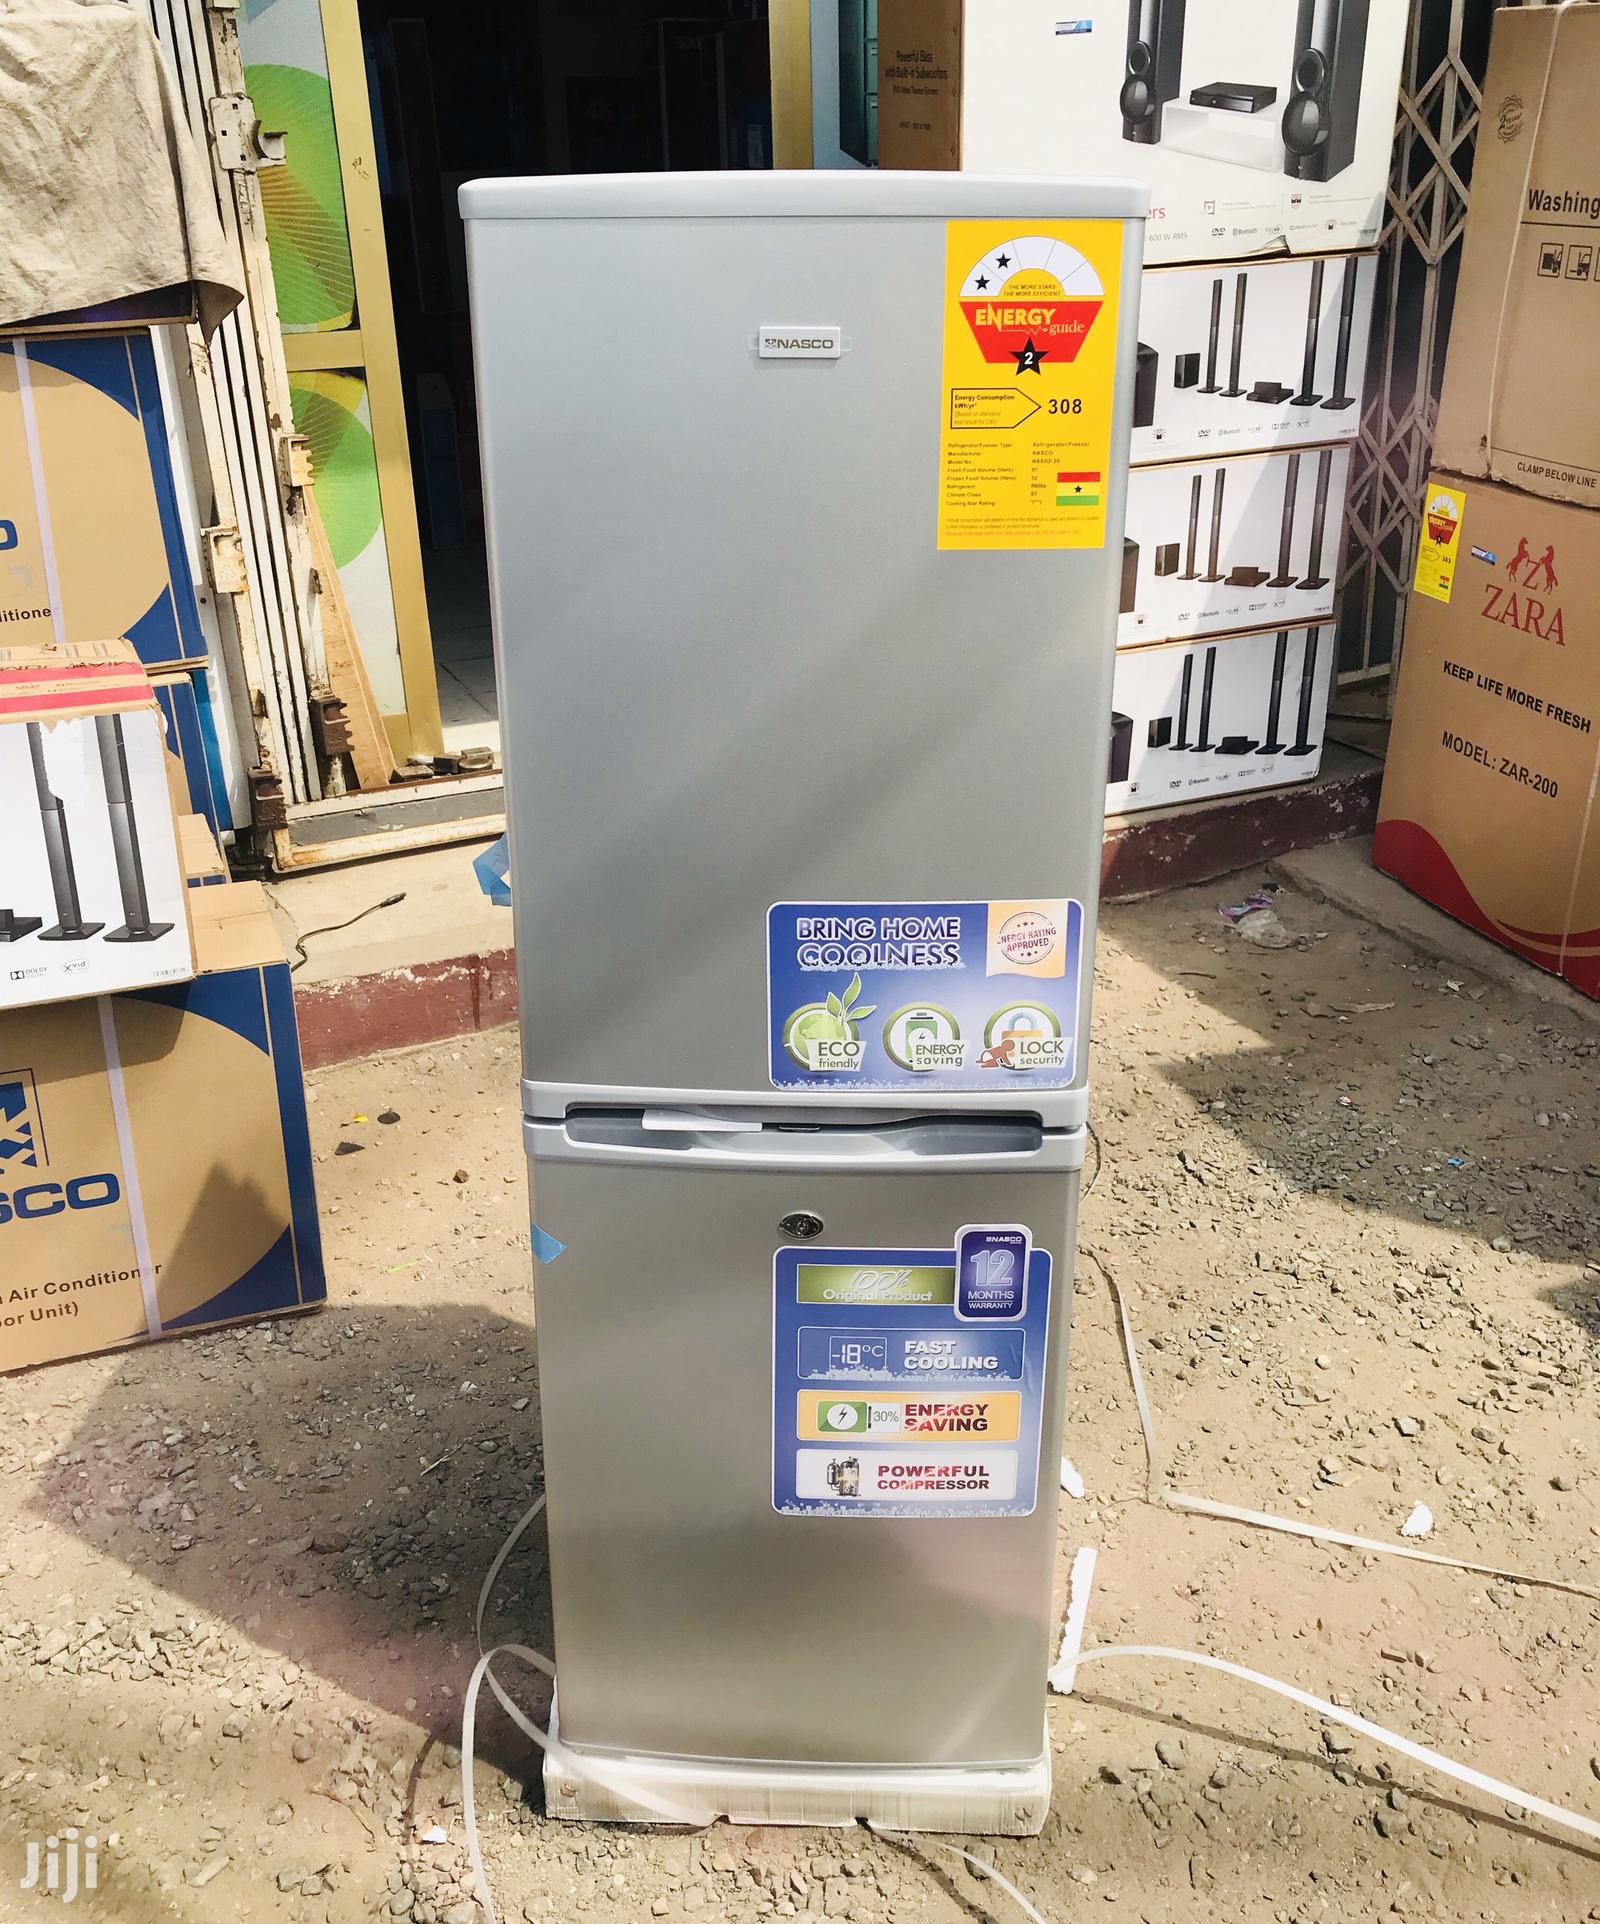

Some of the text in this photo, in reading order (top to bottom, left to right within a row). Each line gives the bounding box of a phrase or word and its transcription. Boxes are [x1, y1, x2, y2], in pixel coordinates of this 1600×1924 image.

[1528, 188, 1600, 219] Washing
[1149, 234, 1162, 242] 600
[1172, 232, 1188, 240] RMS
[975, 303, 1057, 332] ENERGY
[1049, 319, 1085, 336] guide
[777, 339, 834, 349] NASCO
[1024, 352, 1034, 365] 2
[1048, 398, 1083, 415] 308
[1517, 461, 1597, 489] CLAMP BELOW LINE
[1481, 583, 1566, 646] ZARA
[1443, 660, 1592, 734] KEEP LIFE MORE FRESH
[1442, 730, 1559, 798] MODEL: ZAR-200
[797, 916, 961, 940] BRING HOME
[1028, 926, 1057, 939] RATING
[1007, 937, 1050, 952] APPROVED
[797, 942, 961, 969] COOLNESS
[818, 1041, 861, 1057] ECO
[915, 1044, 966, 1056] ENERGY
[1020, 1040, 1065, 1055] LOCK
[818, 1057, 860, 1070] friendly
[916, 1055, 963, 1067] saving
[1020, 1054, 1065, 1067] security
[0, 1173, 120, 1223] CO
[970, 1249, 1015, 1287] 12
[8, 1264, 162, 1304] Air Conditionr
[851, 1268, 913, 1291] 100%
[823, 1288, 933, 1303] Original Product
[968, 1290, 1015, 1300] MONTHS
[30, 1301, 79, 1323] Unit)
[904, 1340, 957, 1355] FAST
[904, 1356, 999, 1371] COOLING
[873, 1410, 899, 1424] 30%
[904, 1403, 989, 1417] ENERGY
[904, 1418, 988, 1432] SAVING
[878, 1465, 990, 1478] POWERFUL
[877, 1479, 990, 1490] COMPRESSOR
